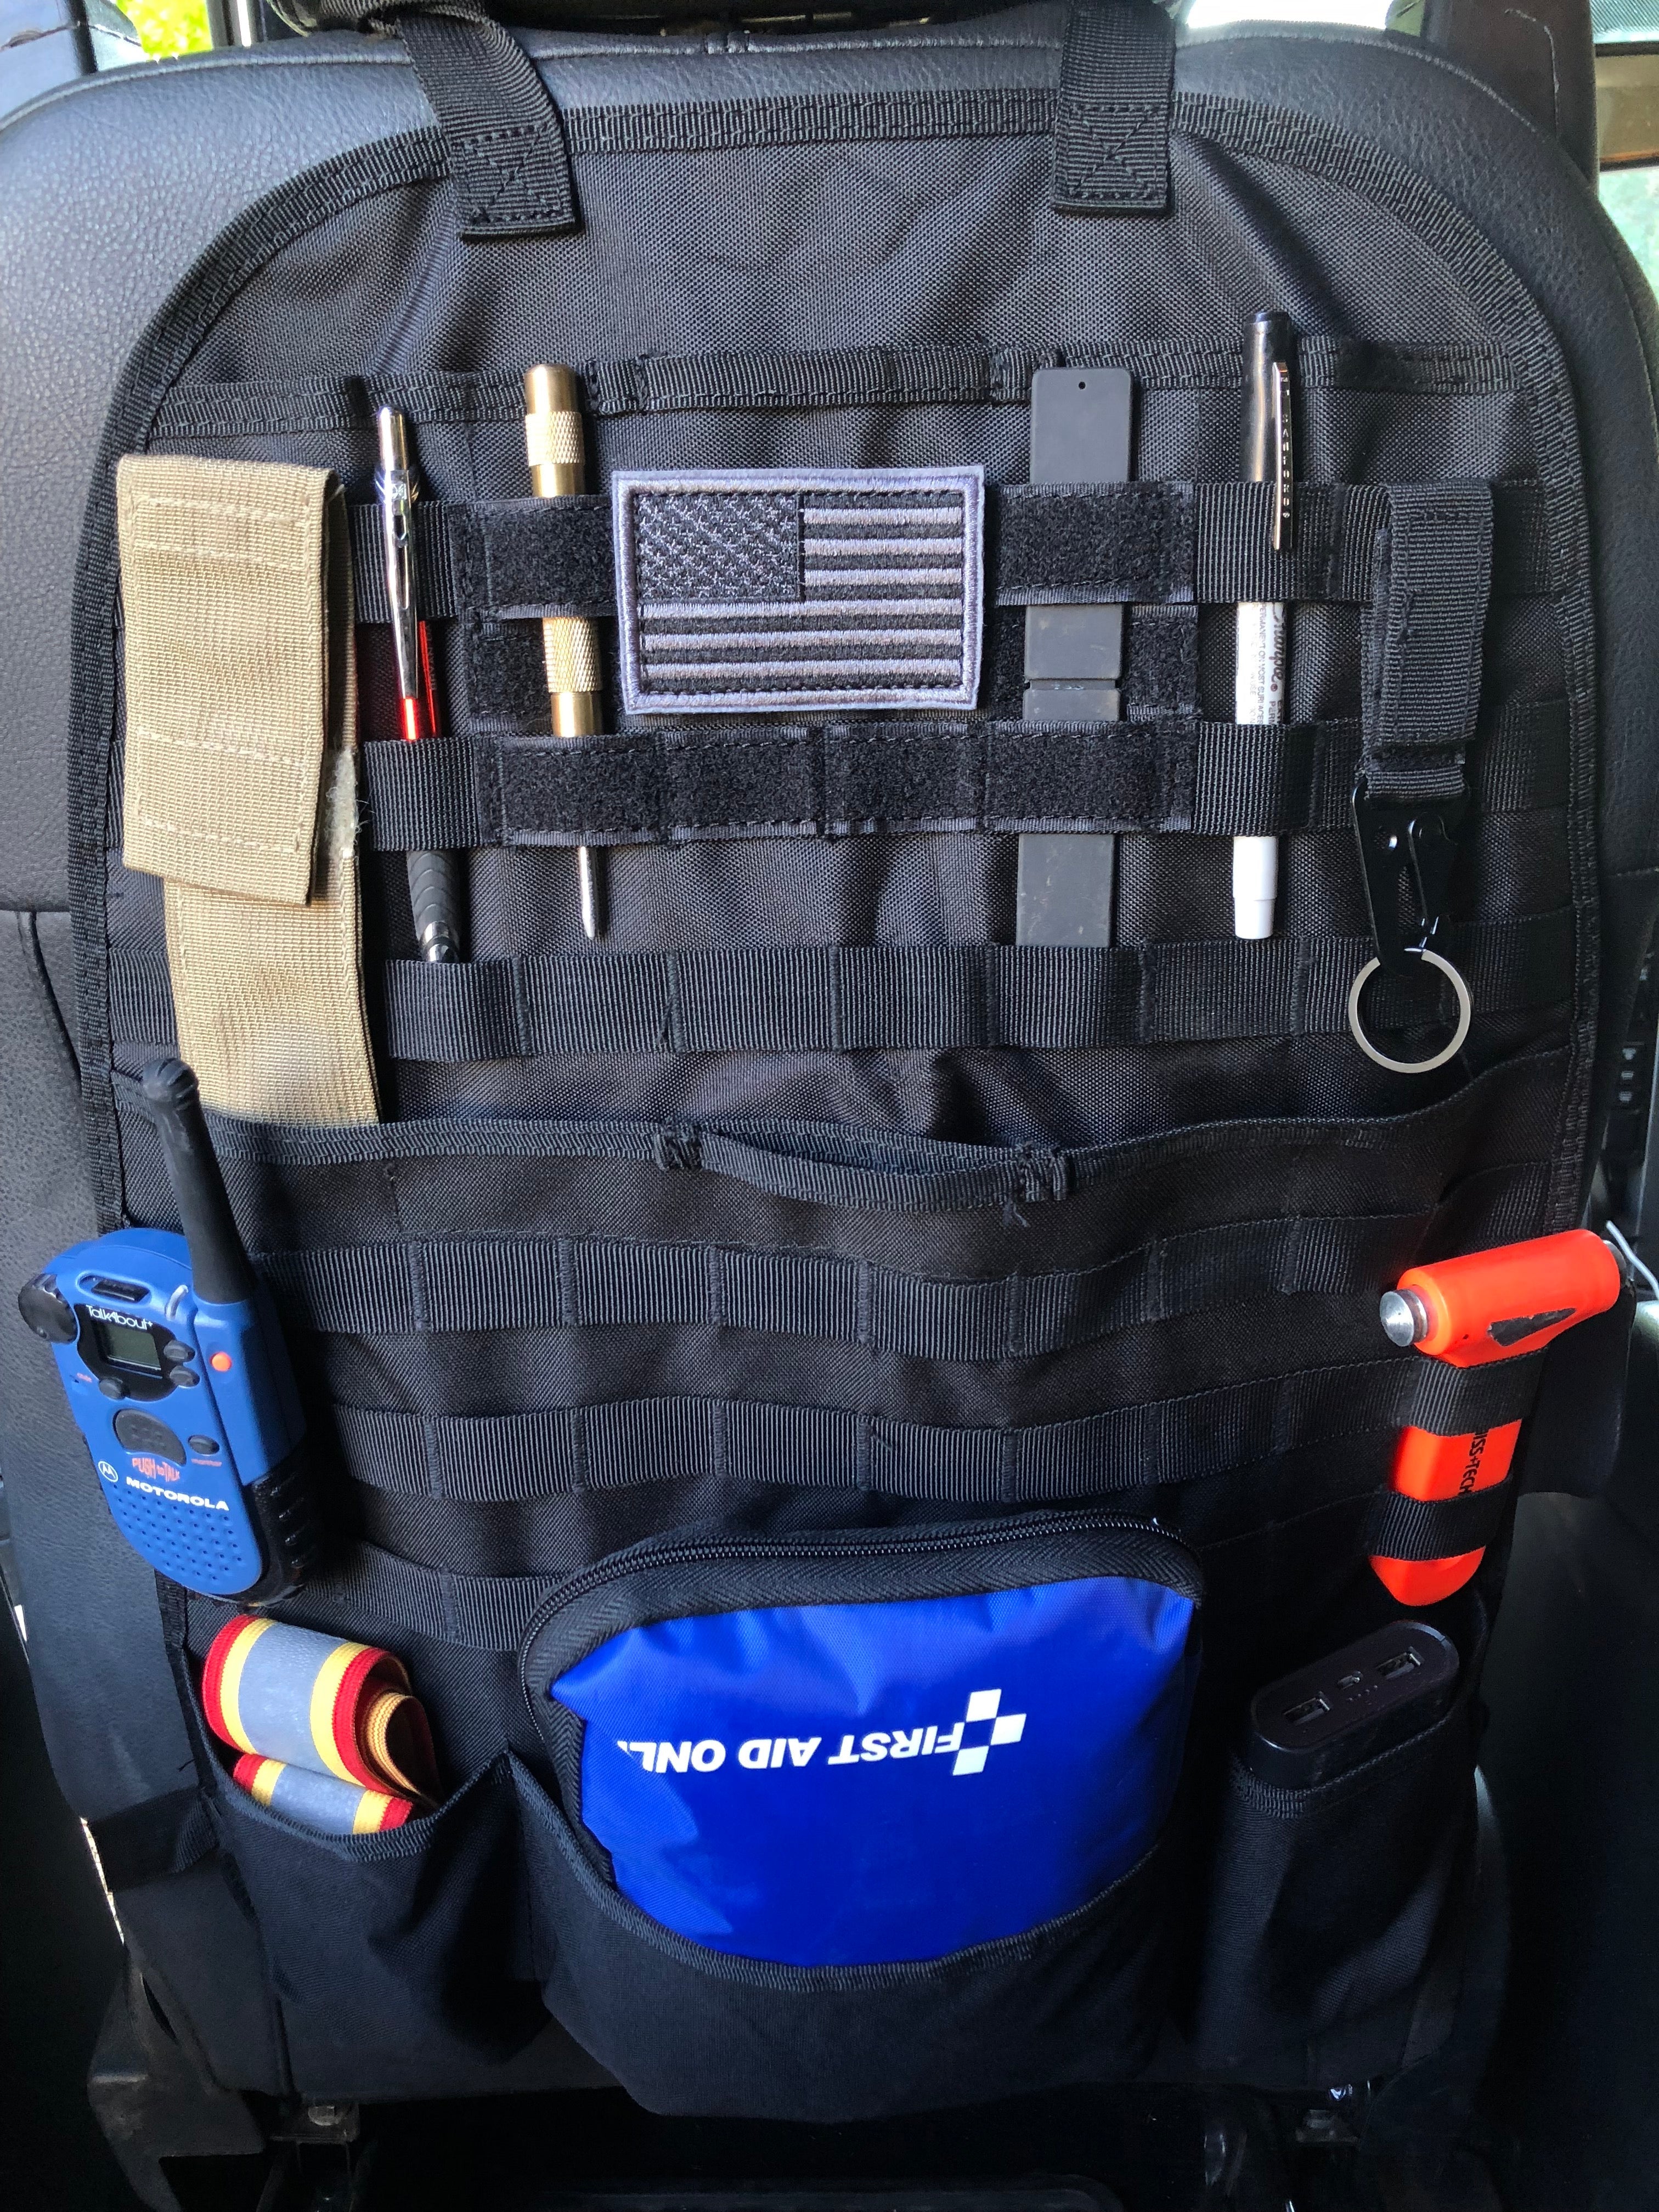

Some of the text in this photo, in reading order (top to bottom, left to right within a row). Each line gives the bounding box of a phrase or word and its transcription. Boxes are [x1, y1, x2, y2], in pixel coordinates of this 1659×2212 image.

[132, 1457, 156, 1480] PUSH
[162, 1462, 180, 1482] TALK
[1459, 1431, 1488, 1496] ISS+TECH
[126, 1476, 229, 1511] MOTOROLA
[617, 1721, 964, 1773] FIRST AID ONL
